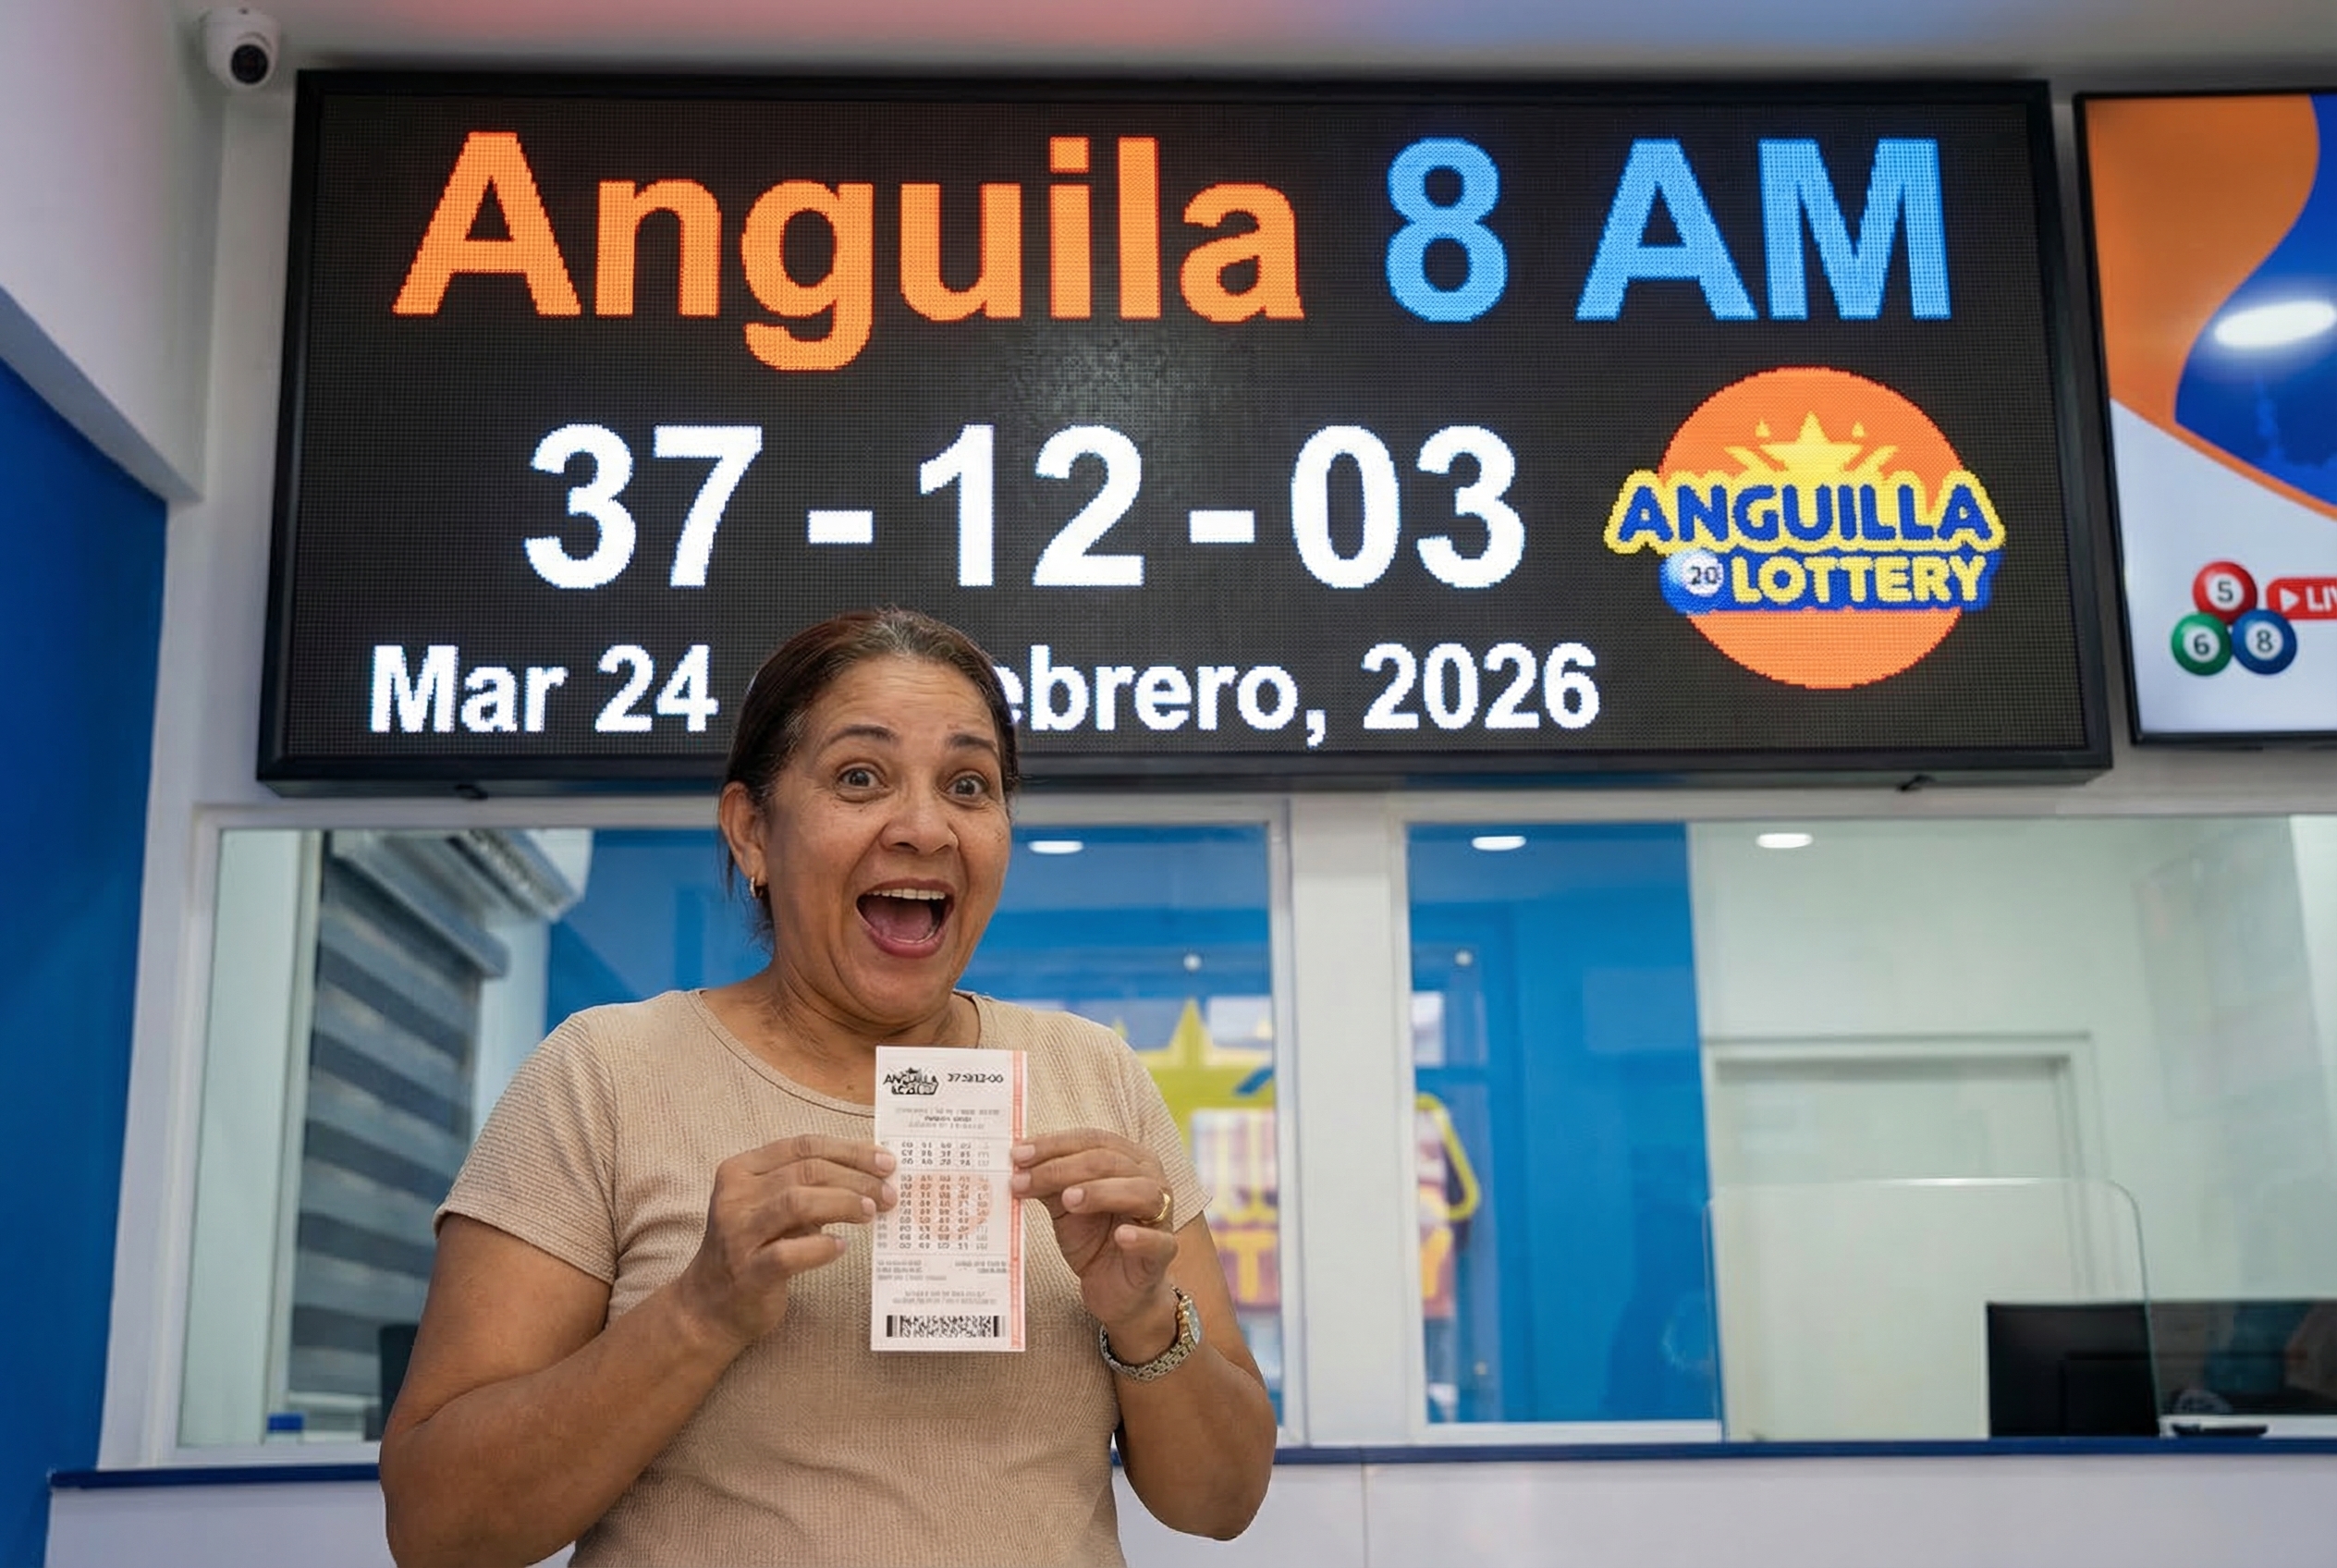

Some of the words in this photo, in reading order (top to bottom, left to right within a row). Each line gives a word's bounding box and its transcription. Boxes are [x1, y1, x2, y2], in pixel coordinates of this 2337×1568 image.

[393, 131, 1304, 371] Anguila
[1385, 138, 1508, 322] 8
[1576, 139, 1951, 320] AM
[523, 424, 763, 589] 37
[919, 425, 1144, 588] 12
[1291, 425, 1525, 588] 03
[1618, 484, 1992, 542] ANGUILLA
[1690, 566, 1719, 584] 20
[1731, 557, 1985, 602] LOTTERY
[2217, 580, 2233, 603] 5
[2193, 633, 2210, 656] 6
[2256, 629, 2273, 653] 8
[370, 645, 569, 732] Mar
[595, 644, 718, 732] 24
[992, 644, 1326, 748] brero,
[1361, 643, 1600, 730] 2026
